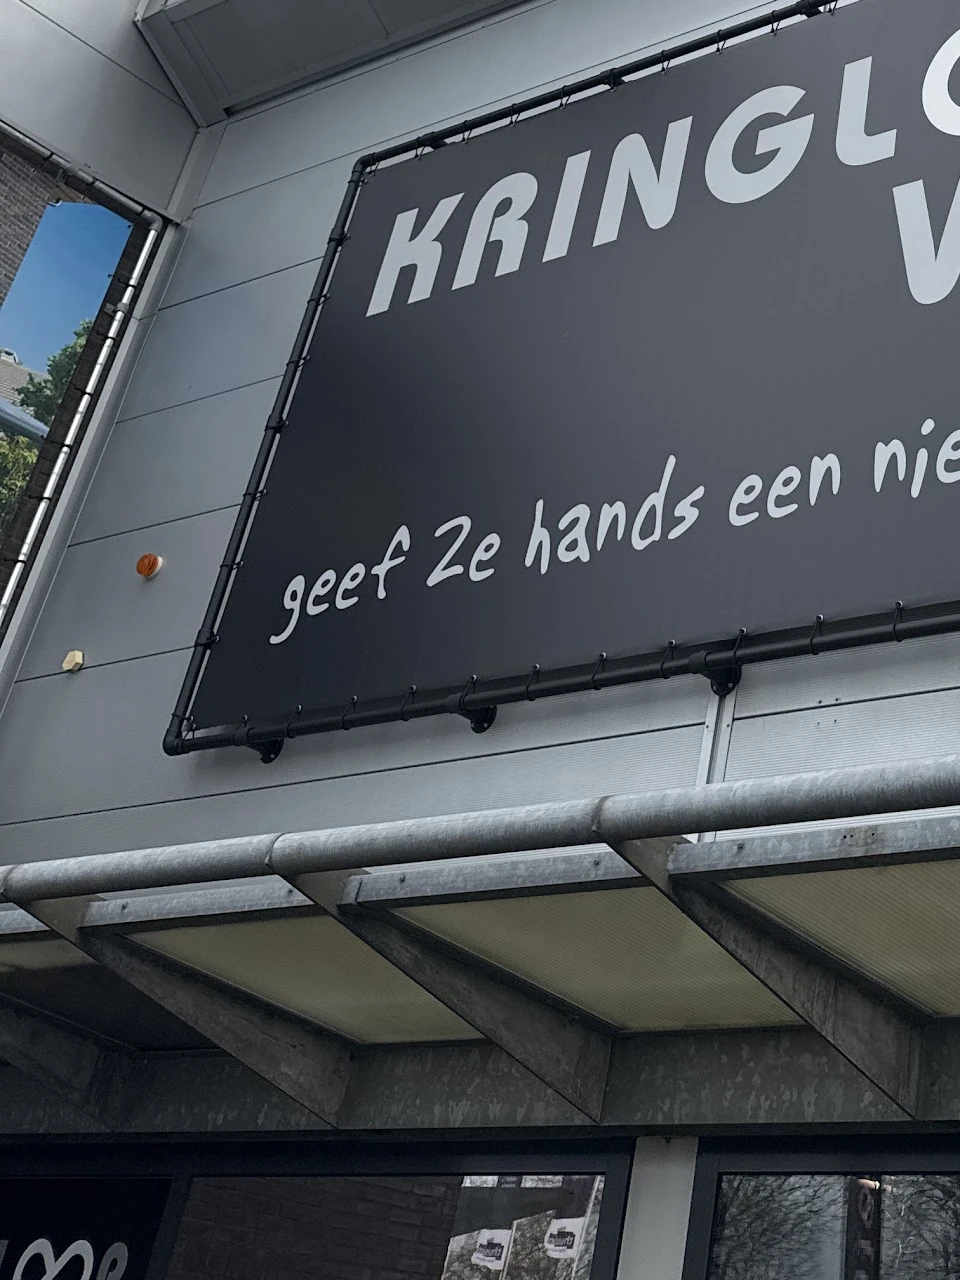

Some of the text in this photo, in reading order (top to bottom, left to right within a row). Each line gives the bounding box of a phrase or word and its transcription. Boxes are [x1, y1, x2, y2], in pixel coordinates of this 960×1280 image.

[269, 524, 411, 644] geef
[427, 516, 501, 587] 2e
[525, 454, 705, 575] hands
[729, 452, 841, 527] een
